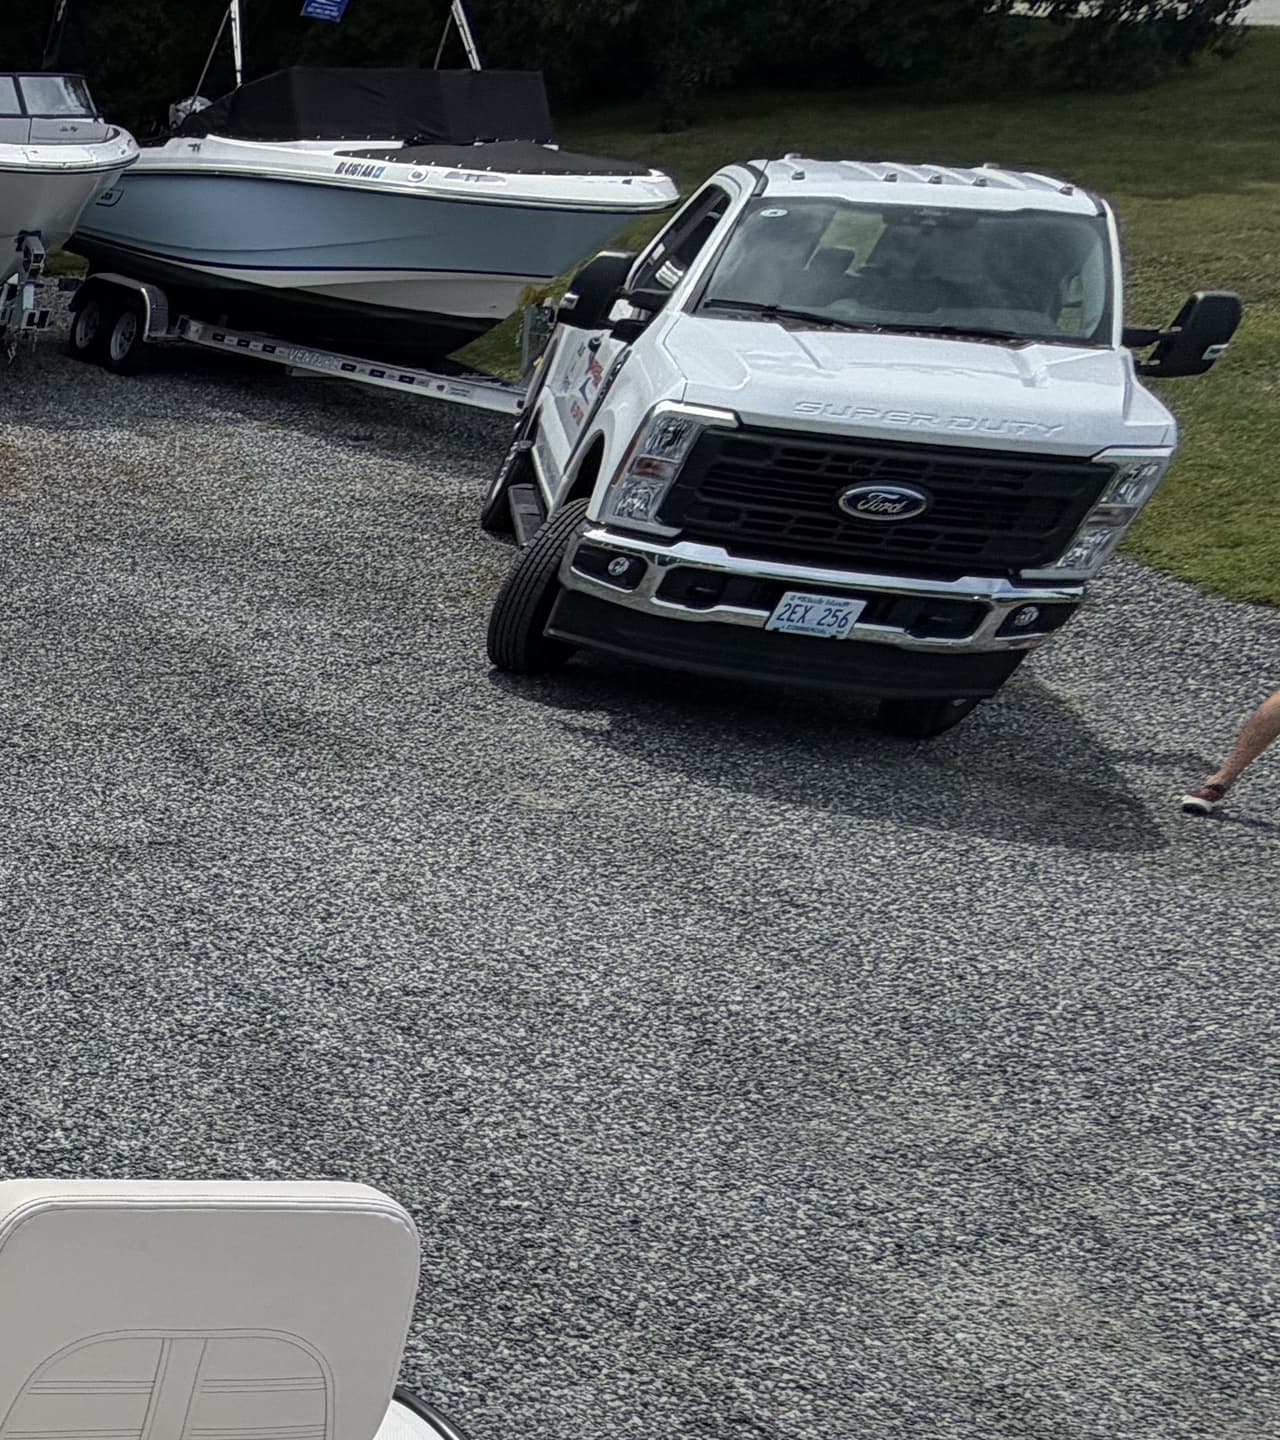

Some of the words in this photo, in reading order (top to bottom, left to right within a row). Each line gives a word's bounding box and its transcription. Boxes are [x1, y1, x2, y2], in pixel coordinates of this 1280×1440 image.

[792, 400, 939, 427] SUPER
[945, 415, 1064, 438] DUTY
[856, 492, 908, 514] Ford
[776, 603, 814, 624] 2EX
[816, 607, 852, 629] 256
